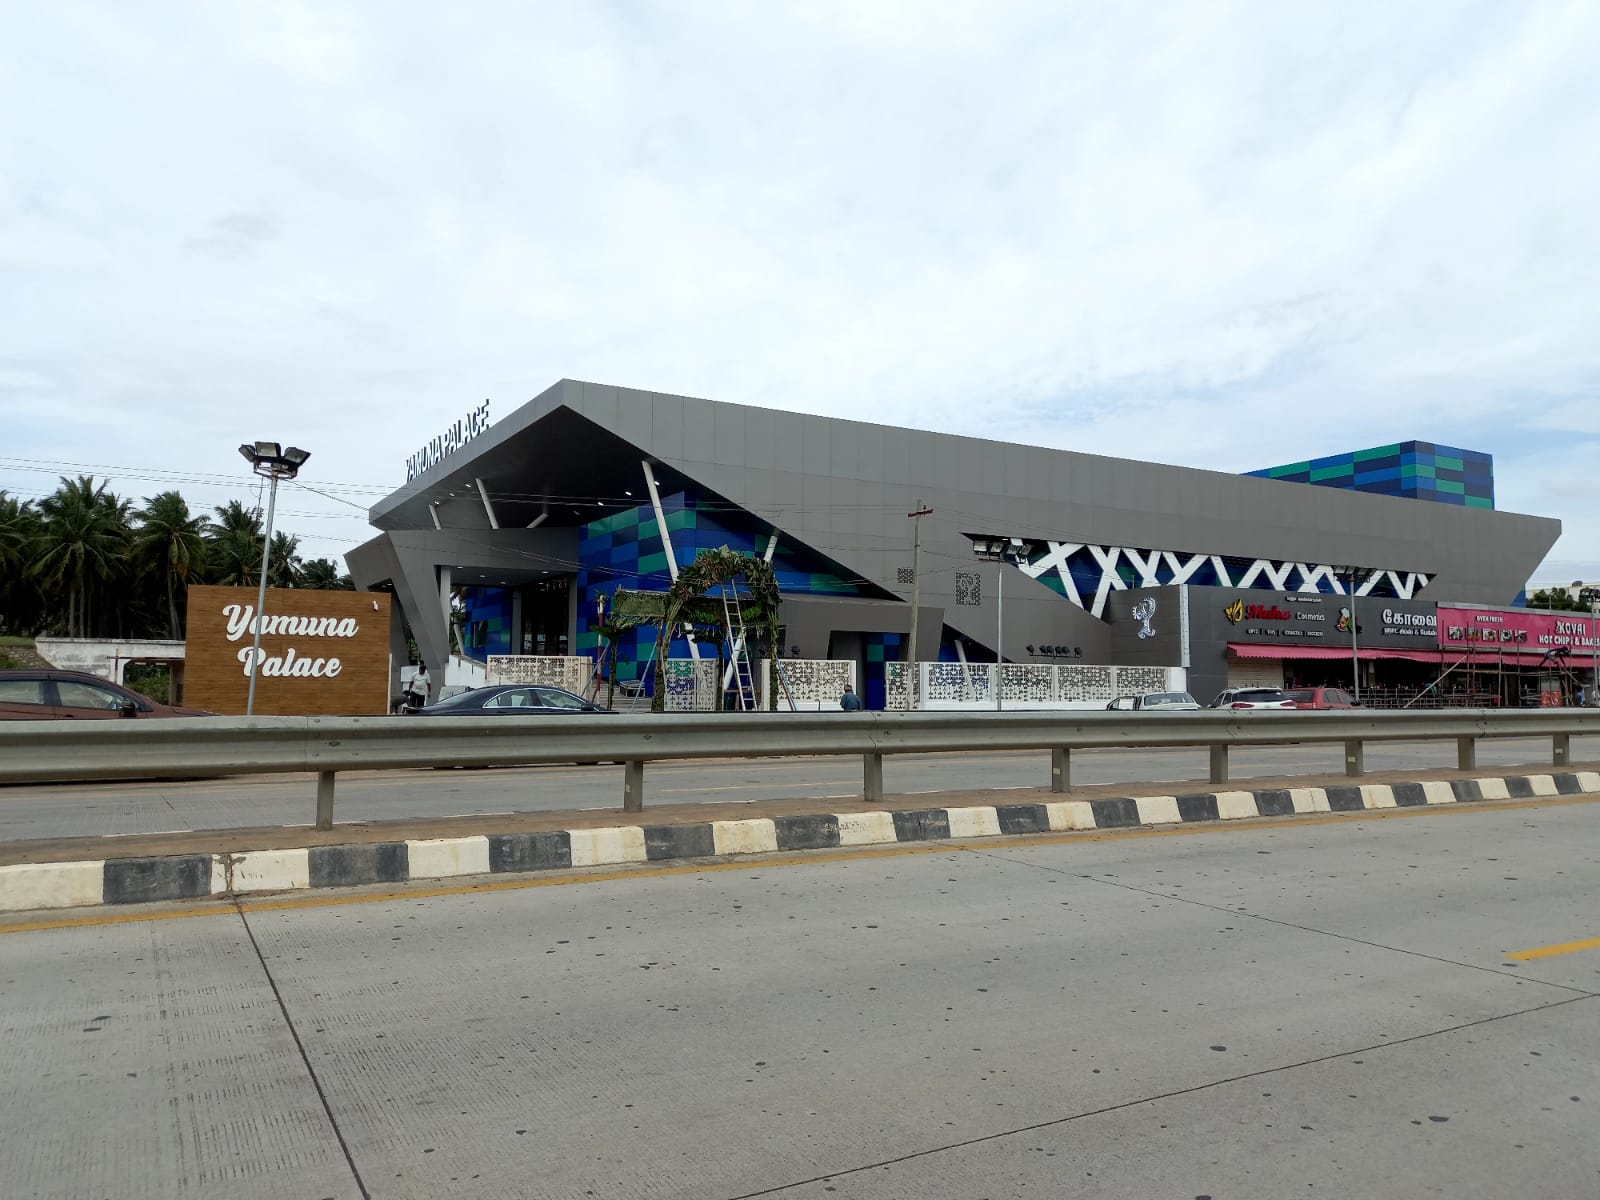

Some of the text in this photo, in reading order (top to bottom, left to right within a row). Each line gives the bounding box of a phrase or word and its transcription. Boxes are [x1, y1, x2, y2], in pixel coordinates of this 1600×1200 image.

[405, 399, 489, 483] YAMUNA PALACE
[222, 604, 359, 641] Yamuna
[1382, 608, 1437, 626] கோவை
[1559, 622, 1586, 635] KOVAI
[1539, 634, 1553, 644] HOT
[1574, 636, 1580, 645] &
[237, 646, 342, 677] Palace
